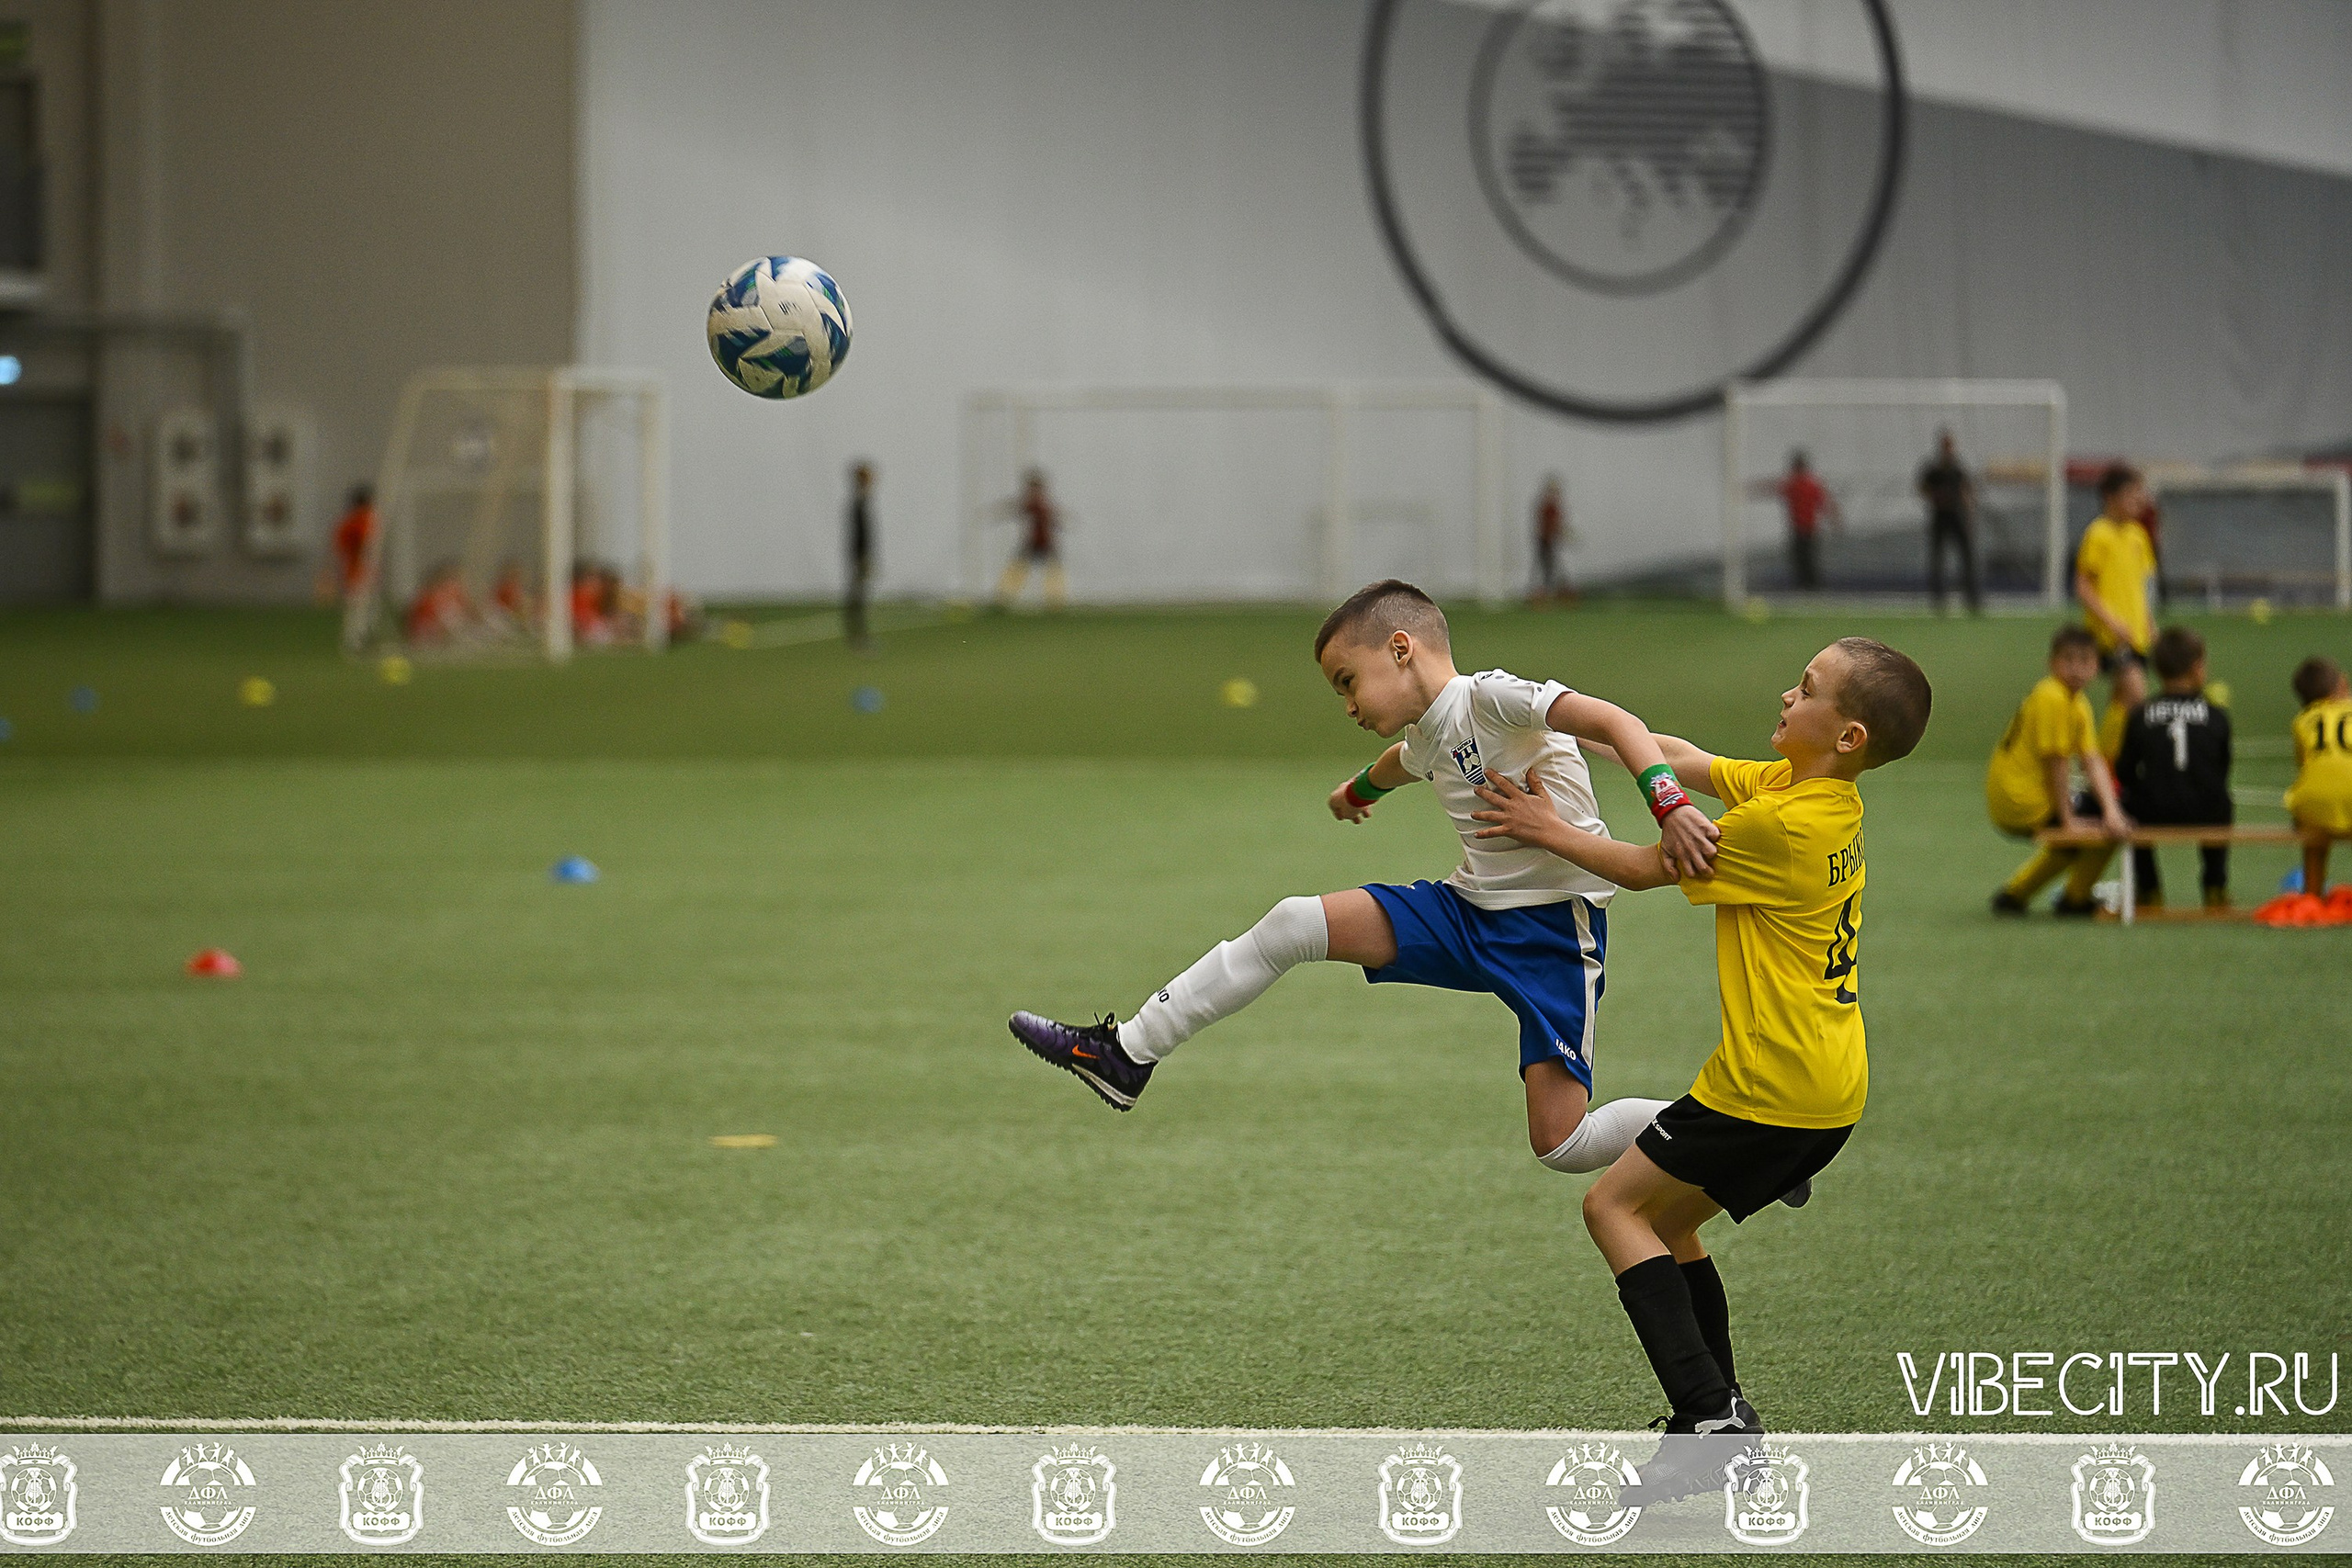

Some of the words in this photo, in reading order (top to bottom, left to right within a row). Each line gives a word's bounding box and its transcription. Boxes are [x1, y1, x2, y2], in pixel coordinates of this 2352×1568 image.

[2168, 716, 2188, 771] 1
[1827, 827, 1865, 887] БРЫК
[1824, 890, 1858, 1004] 4
[1655, 1123, 1672, 1141] SPORT
